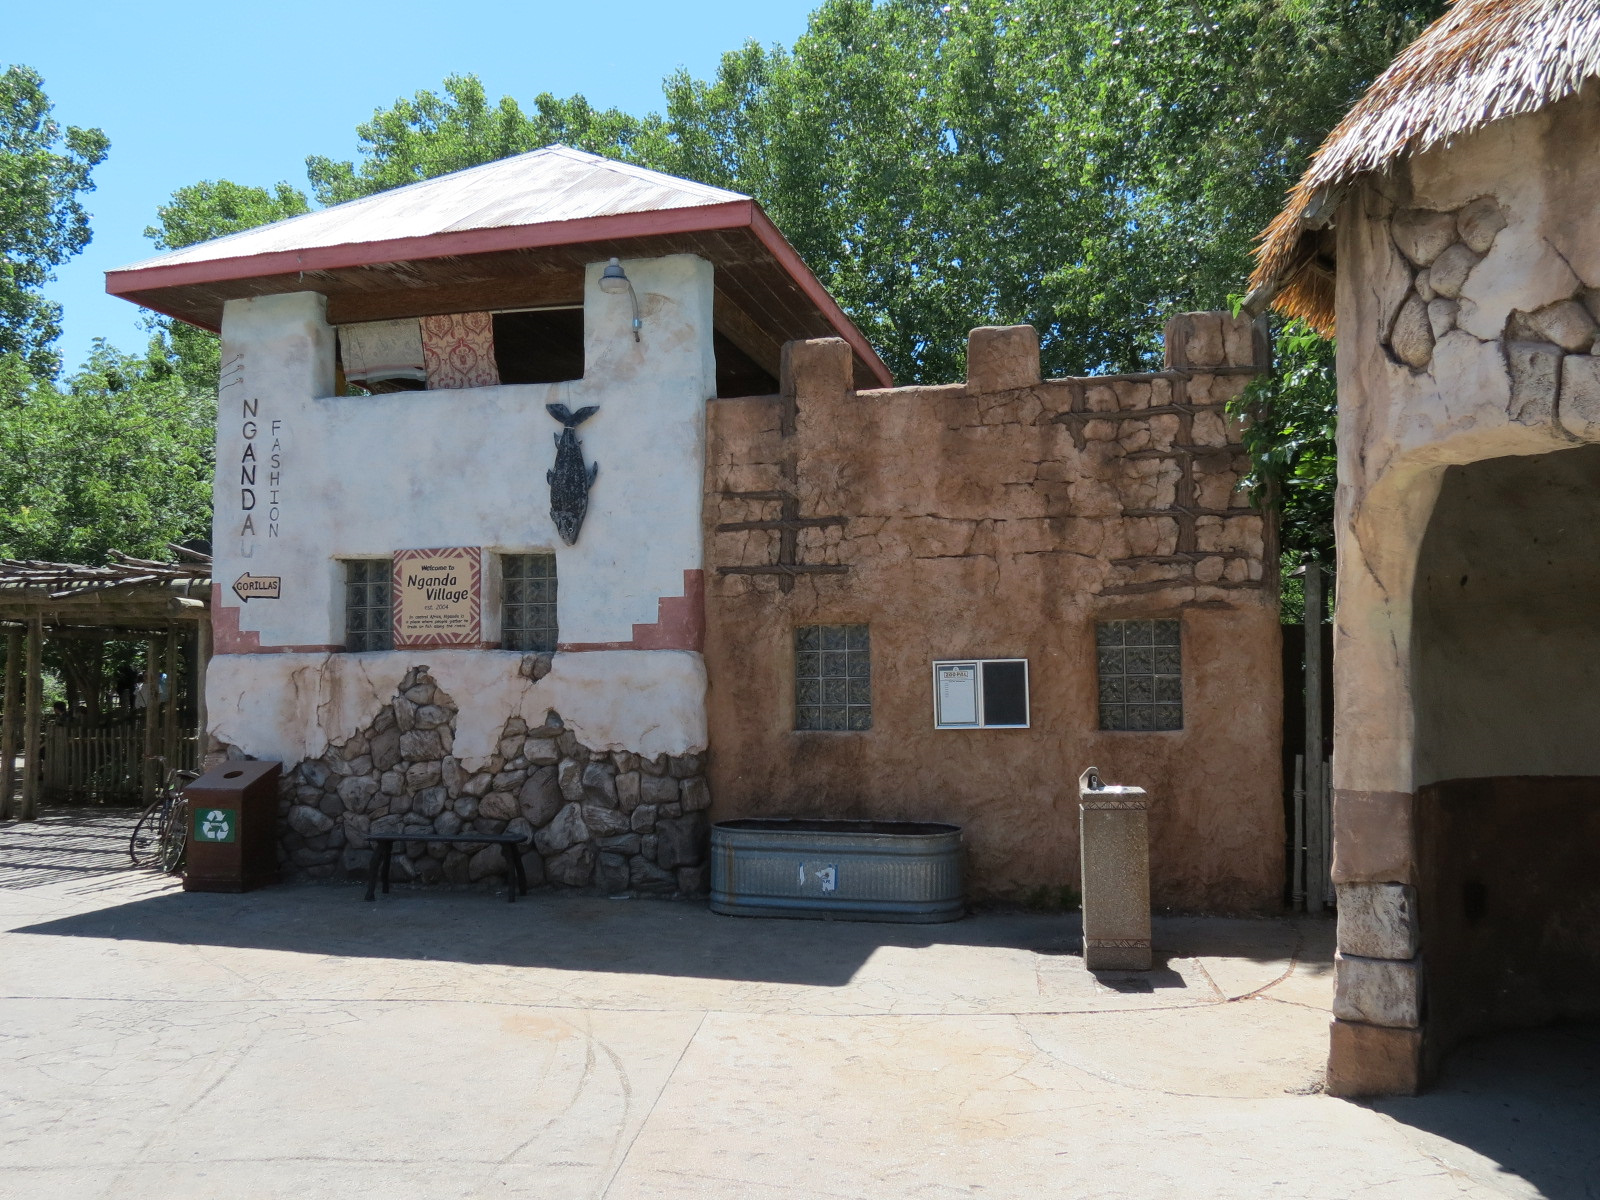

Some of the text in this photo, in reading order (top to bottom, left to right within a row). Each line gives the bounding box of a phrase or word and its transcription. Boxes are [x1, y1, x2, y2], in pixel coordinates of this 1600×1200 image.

[269, 420, 281, 538] FASHION
[236, 581, 278, 591] GORILLAS
[407, 573, 456, 590] Nganda
[426, 588, 469, 604] Village
